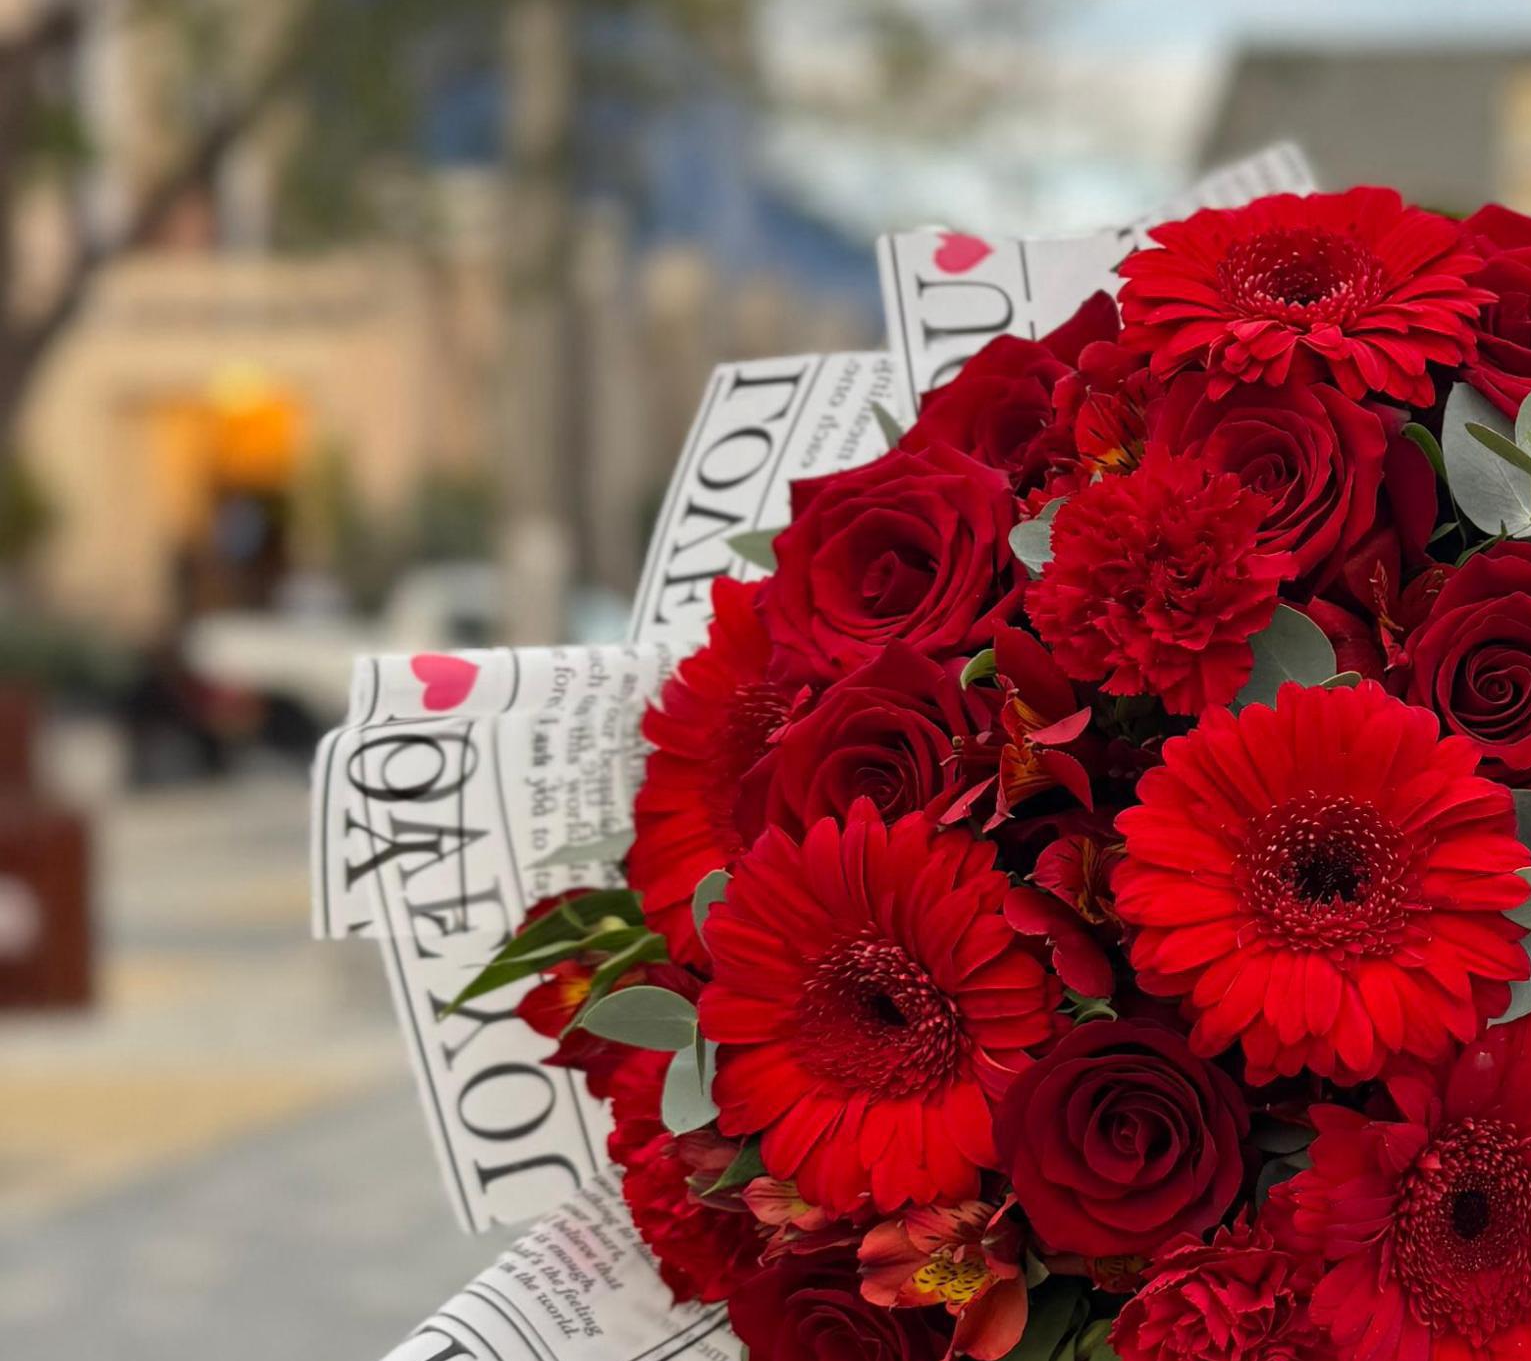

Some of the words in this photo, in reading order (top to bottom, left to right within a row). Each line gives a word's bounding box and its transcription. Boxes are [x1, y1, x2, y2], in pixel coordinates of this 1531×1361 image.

[515, 1272, 540, 1291] the
[540, 1266, 564, 1286] the
[554, 1288, 604, 1338] feeling
